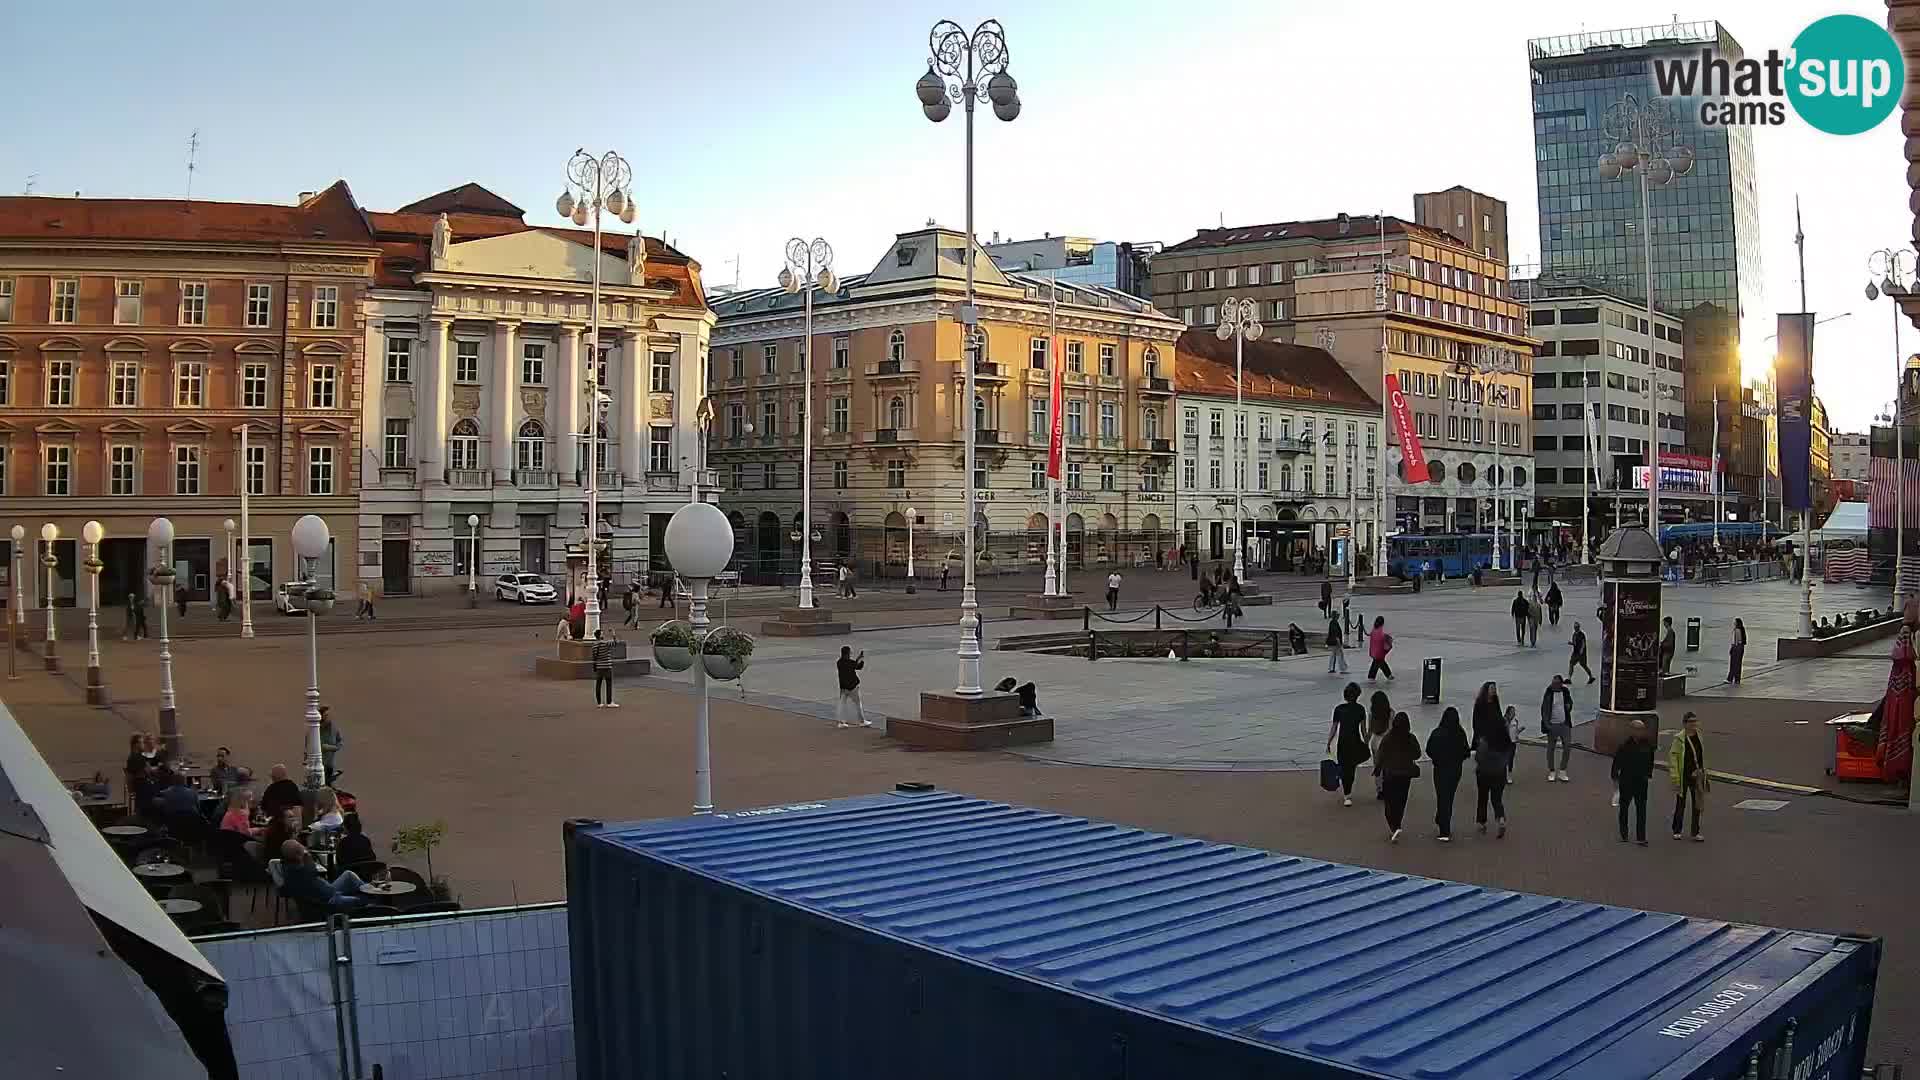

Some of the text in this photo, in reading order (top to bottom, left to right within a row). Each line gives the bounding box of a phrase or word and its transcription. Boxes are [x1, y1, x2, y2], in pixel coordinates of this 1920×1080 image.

[1404, 431, 1418, 466] Zagreb
[960, 490, 995, 501] SGER
[1658, 1016, 1709, 1038] MCDU
[1692, 989, 1747, 1017] 300629
